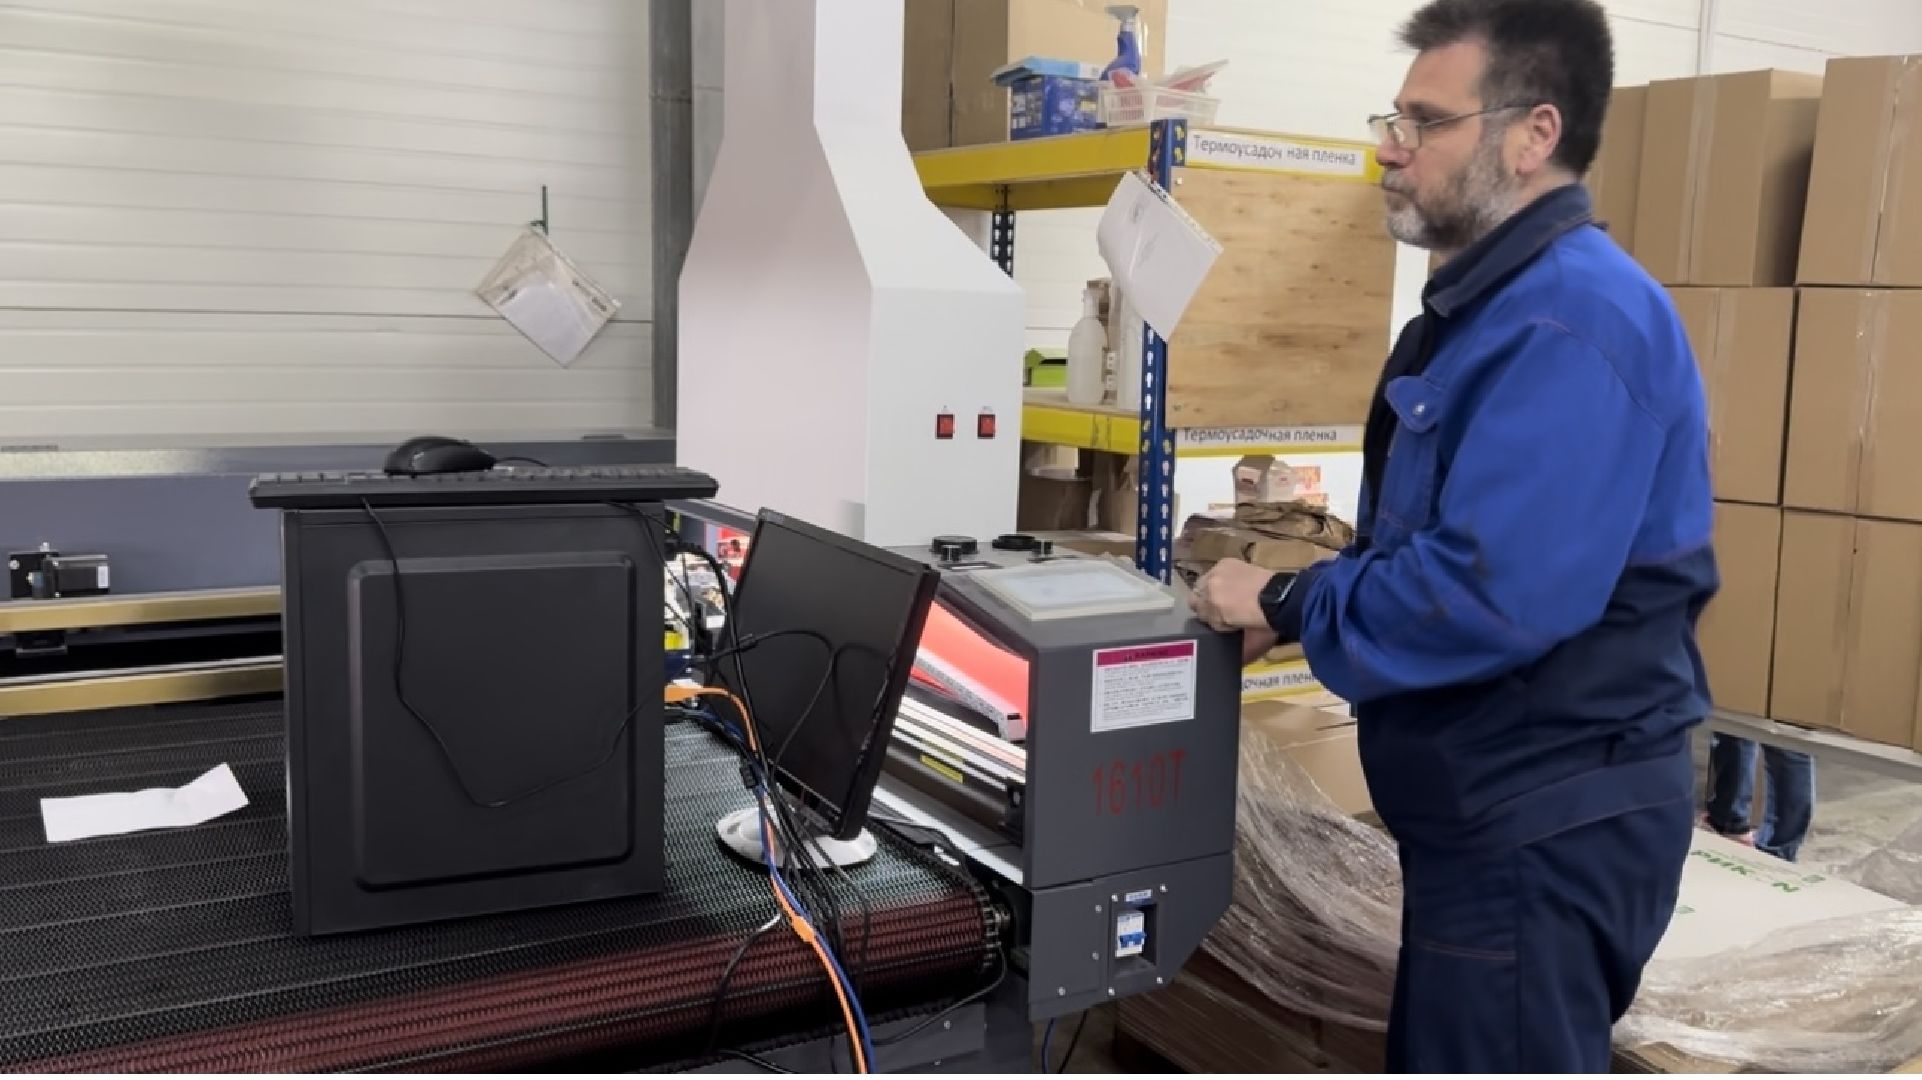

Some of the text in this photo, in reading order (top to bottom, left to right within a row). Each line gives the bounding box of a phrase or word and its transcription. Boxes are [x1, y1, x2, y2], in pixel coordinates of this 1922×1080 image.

[1194, 134, 1356, 166] Термоусадоч ная пленка
[1184, 428, 1337, 443] Термоусадочная пленка
[1282, 672, 1314, 686] плен
[1088, 748, 1187, 817] 1610T
